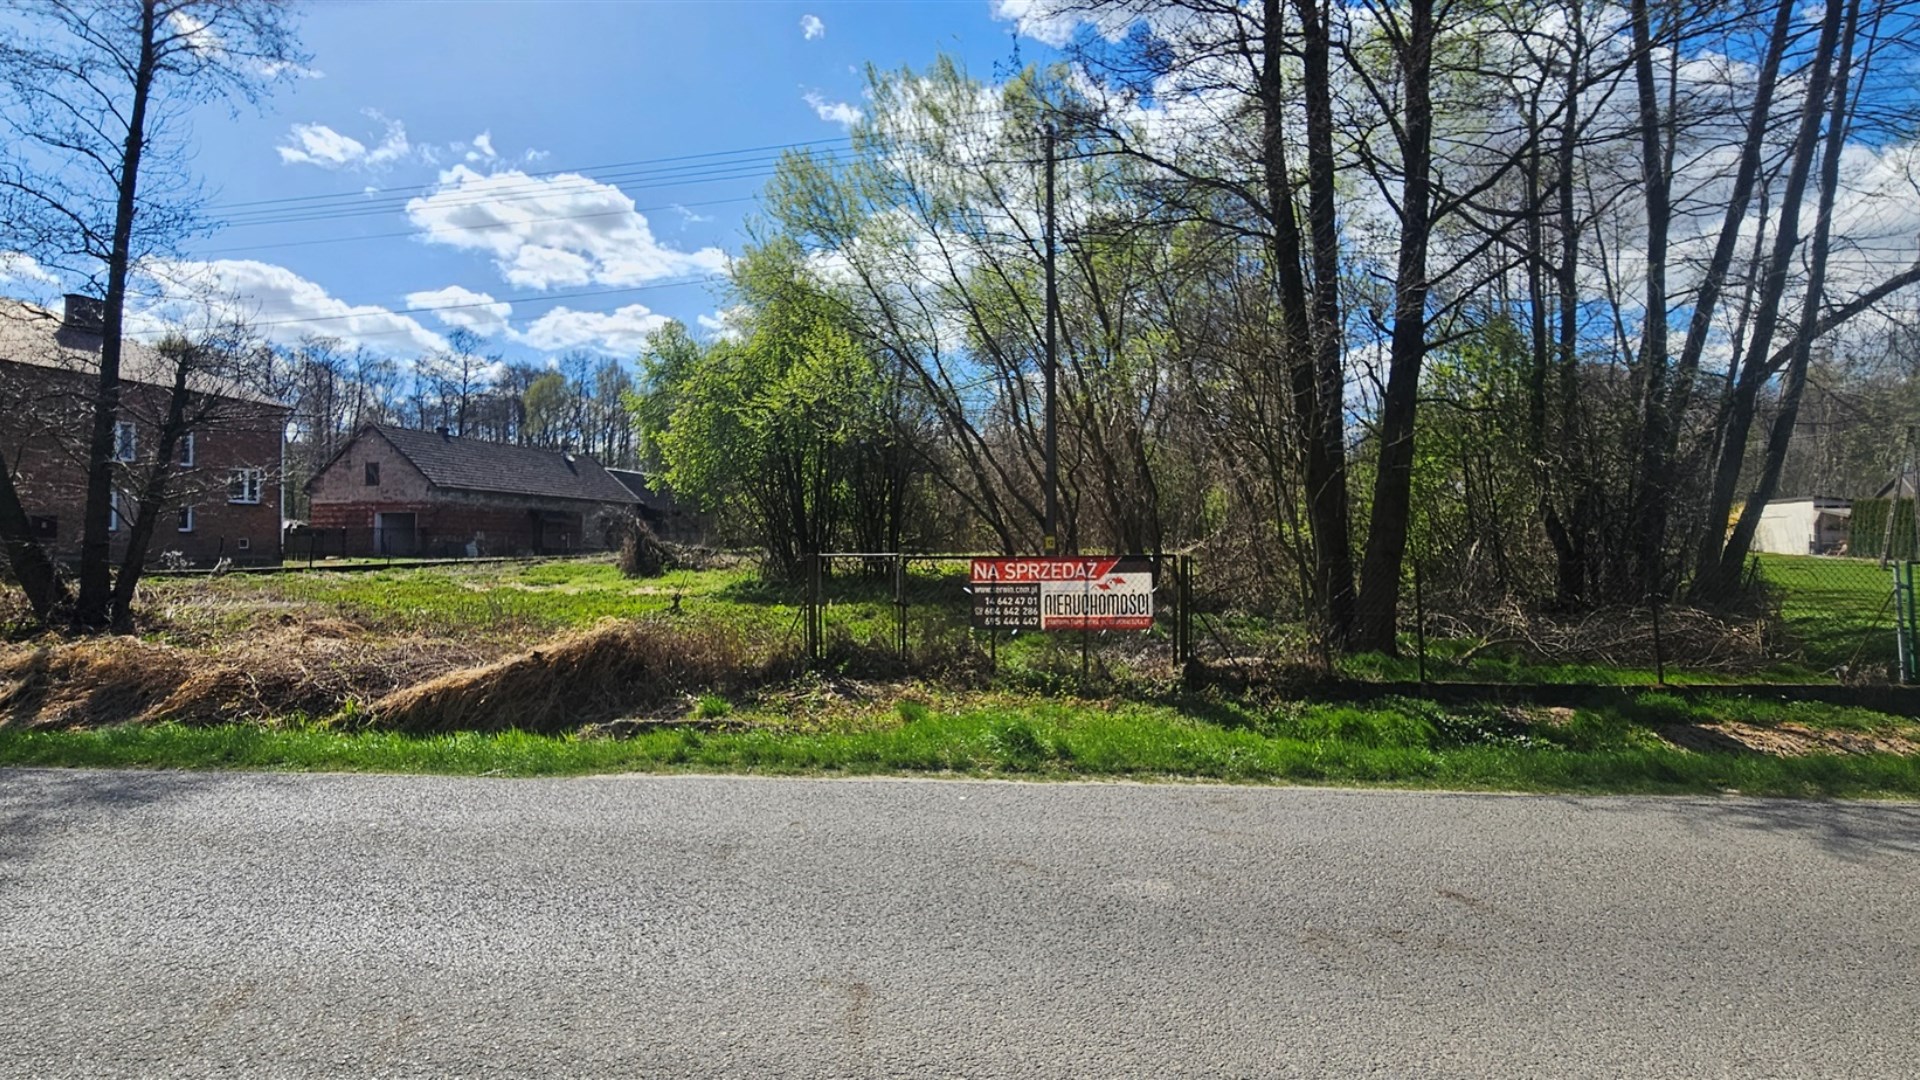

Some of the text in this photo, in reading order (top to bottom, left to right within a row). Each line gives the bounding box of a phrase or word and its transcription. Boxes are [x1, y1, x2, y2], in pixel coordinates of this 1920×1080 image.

[974, 560, 1098, 579] NA SPRZEDAŻ
[997, 597, 1013, 606] 642
[1015, 597, 1026, 605] 47
[1027, 597, 1038, 605] 01
[1044, 589, 1150, 616] NIERUCHOMOŚCI
[1003, 607, 1020, 616] 642
[1003, 617, 1020, 626] 444
[1022, 617, 1039, 626] 447
